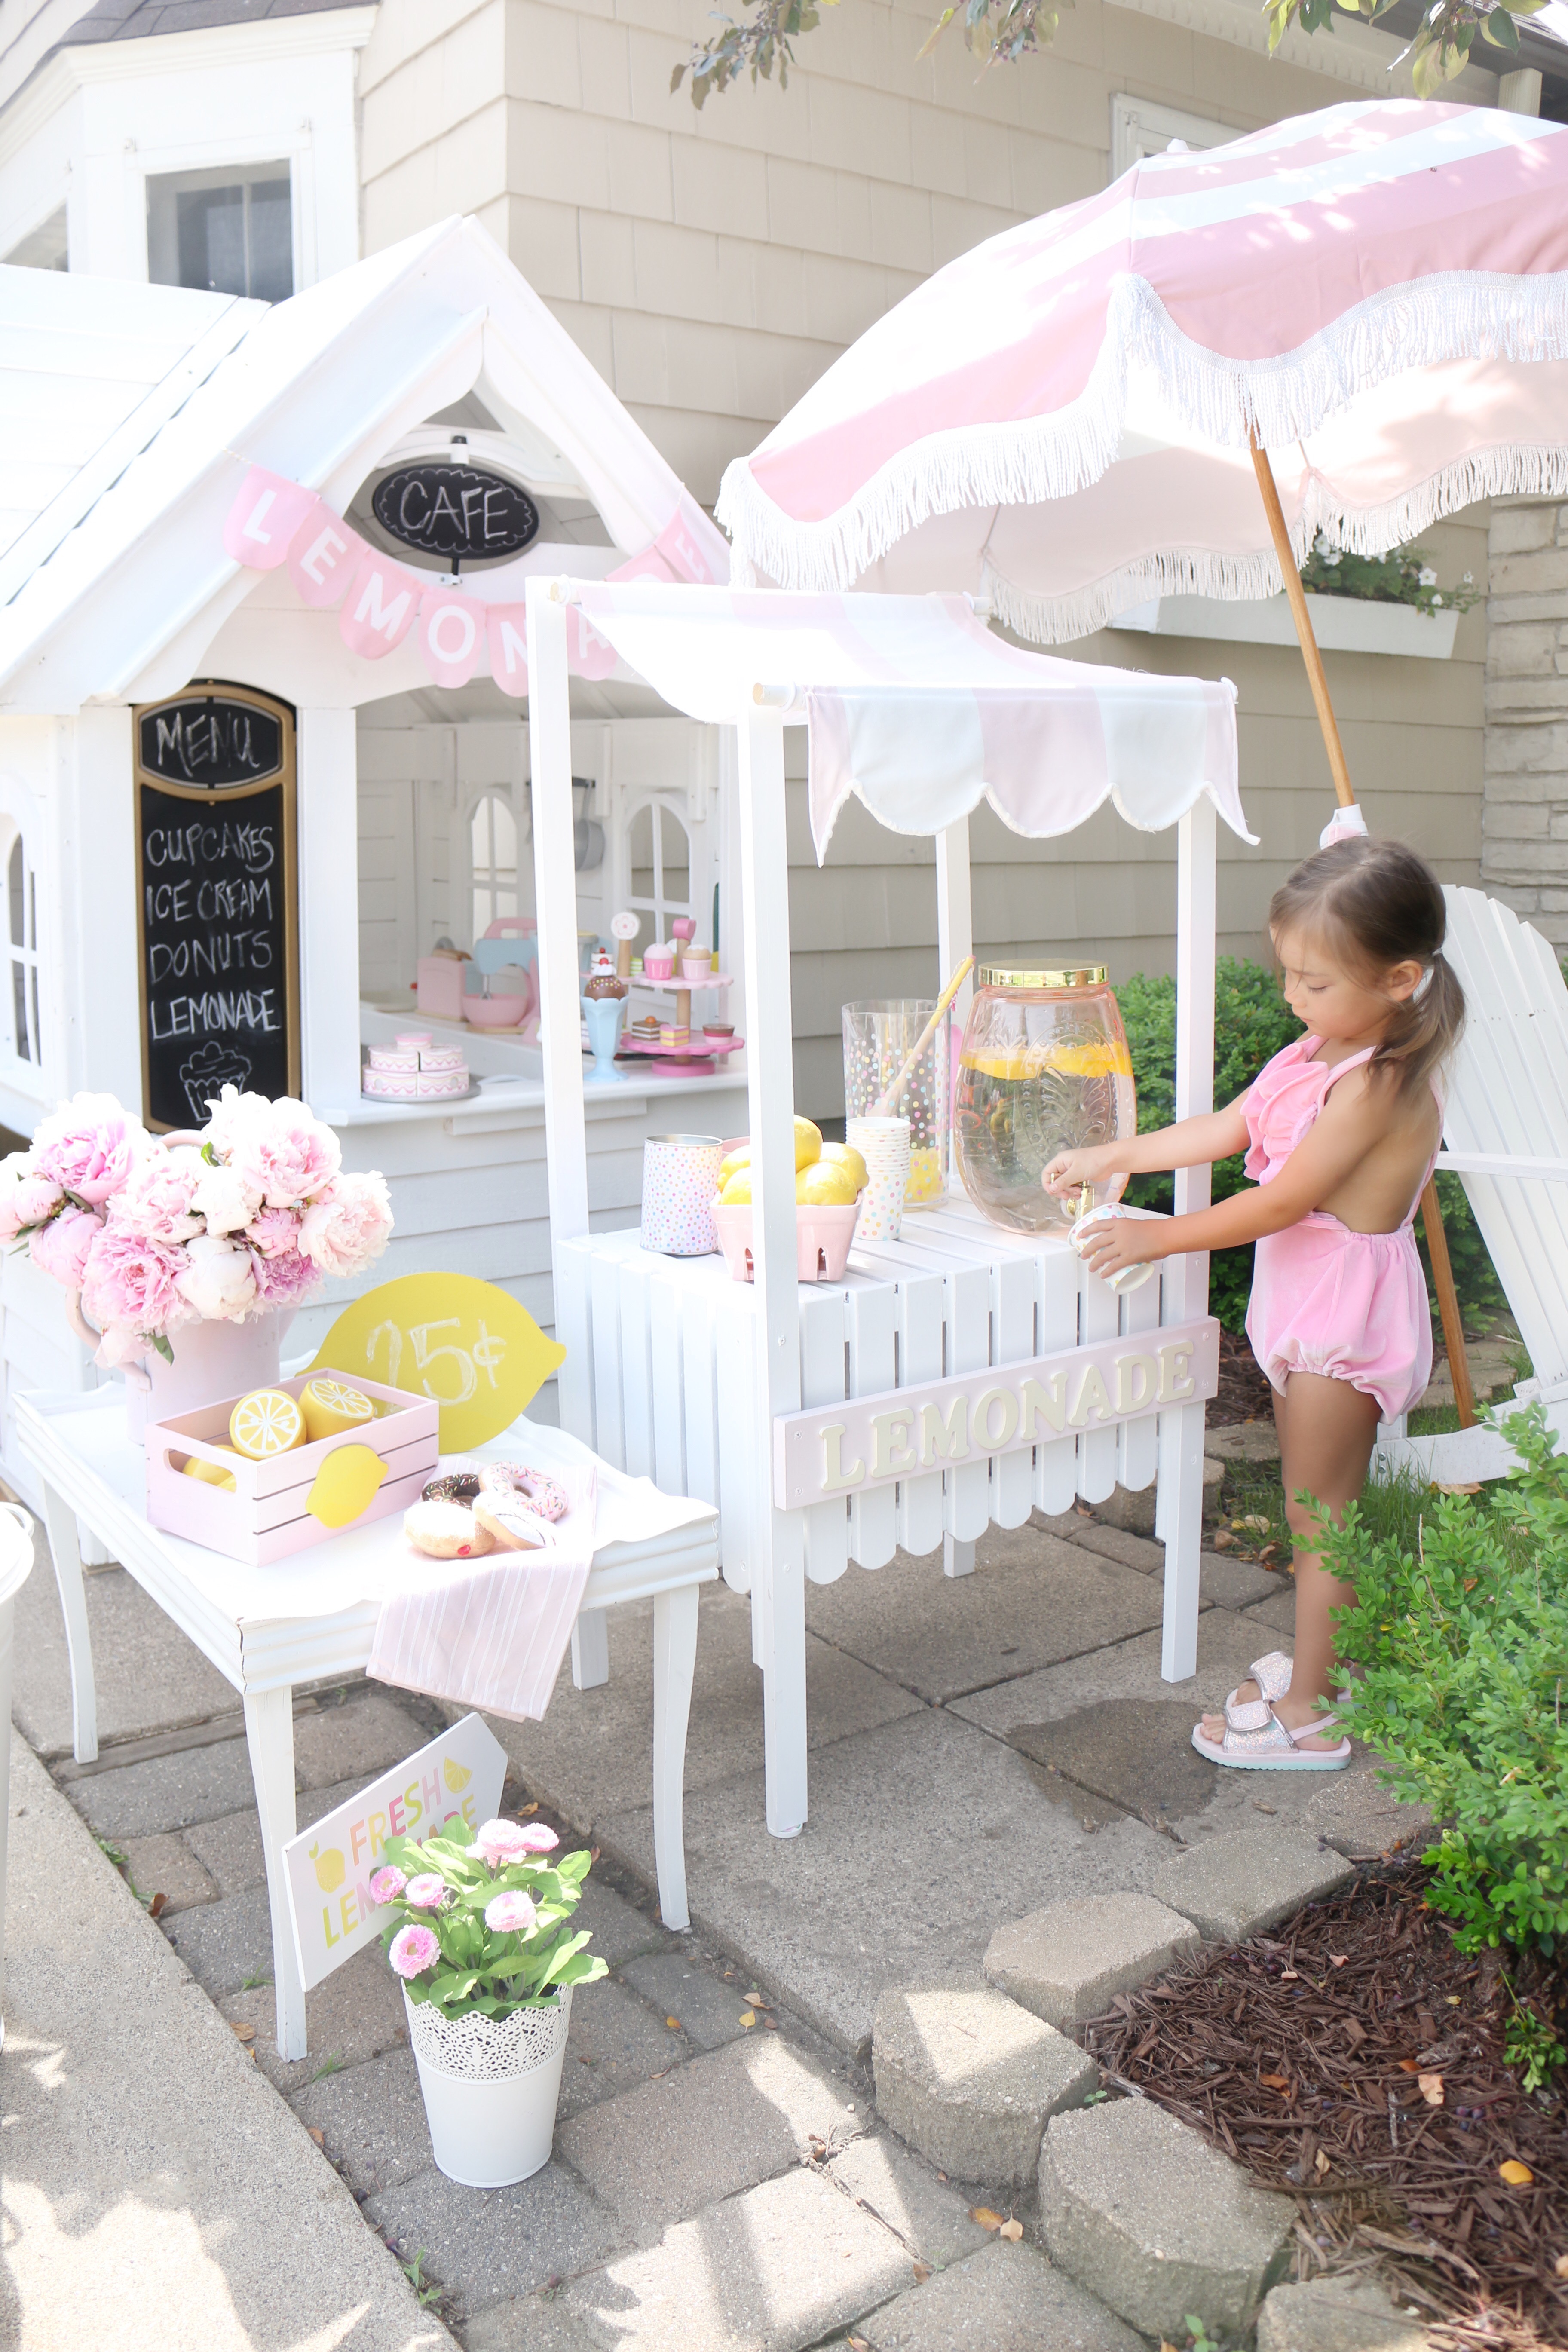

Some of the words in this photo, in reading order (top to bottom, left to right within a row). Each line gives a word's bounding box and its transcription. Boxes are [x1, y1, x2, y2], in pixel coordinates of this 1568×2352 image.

[399, 479, 509, 540] CAFE
[242, 489, 705, 674] LEMONAE
[156, 711, 260, 778] MENU
[146, 821, 275, 873] CUPCAKES
[146, 879, 193, 926] ICE
[197, 878, 273, 921] CREAM
[150, 929, 273, 986] DONUTS
[151, 988, 281, 1040] LEMONADE
[818, 1340, 1195, 1491] LEMONADE
[349, 1767, 441, 1867] FRESH
